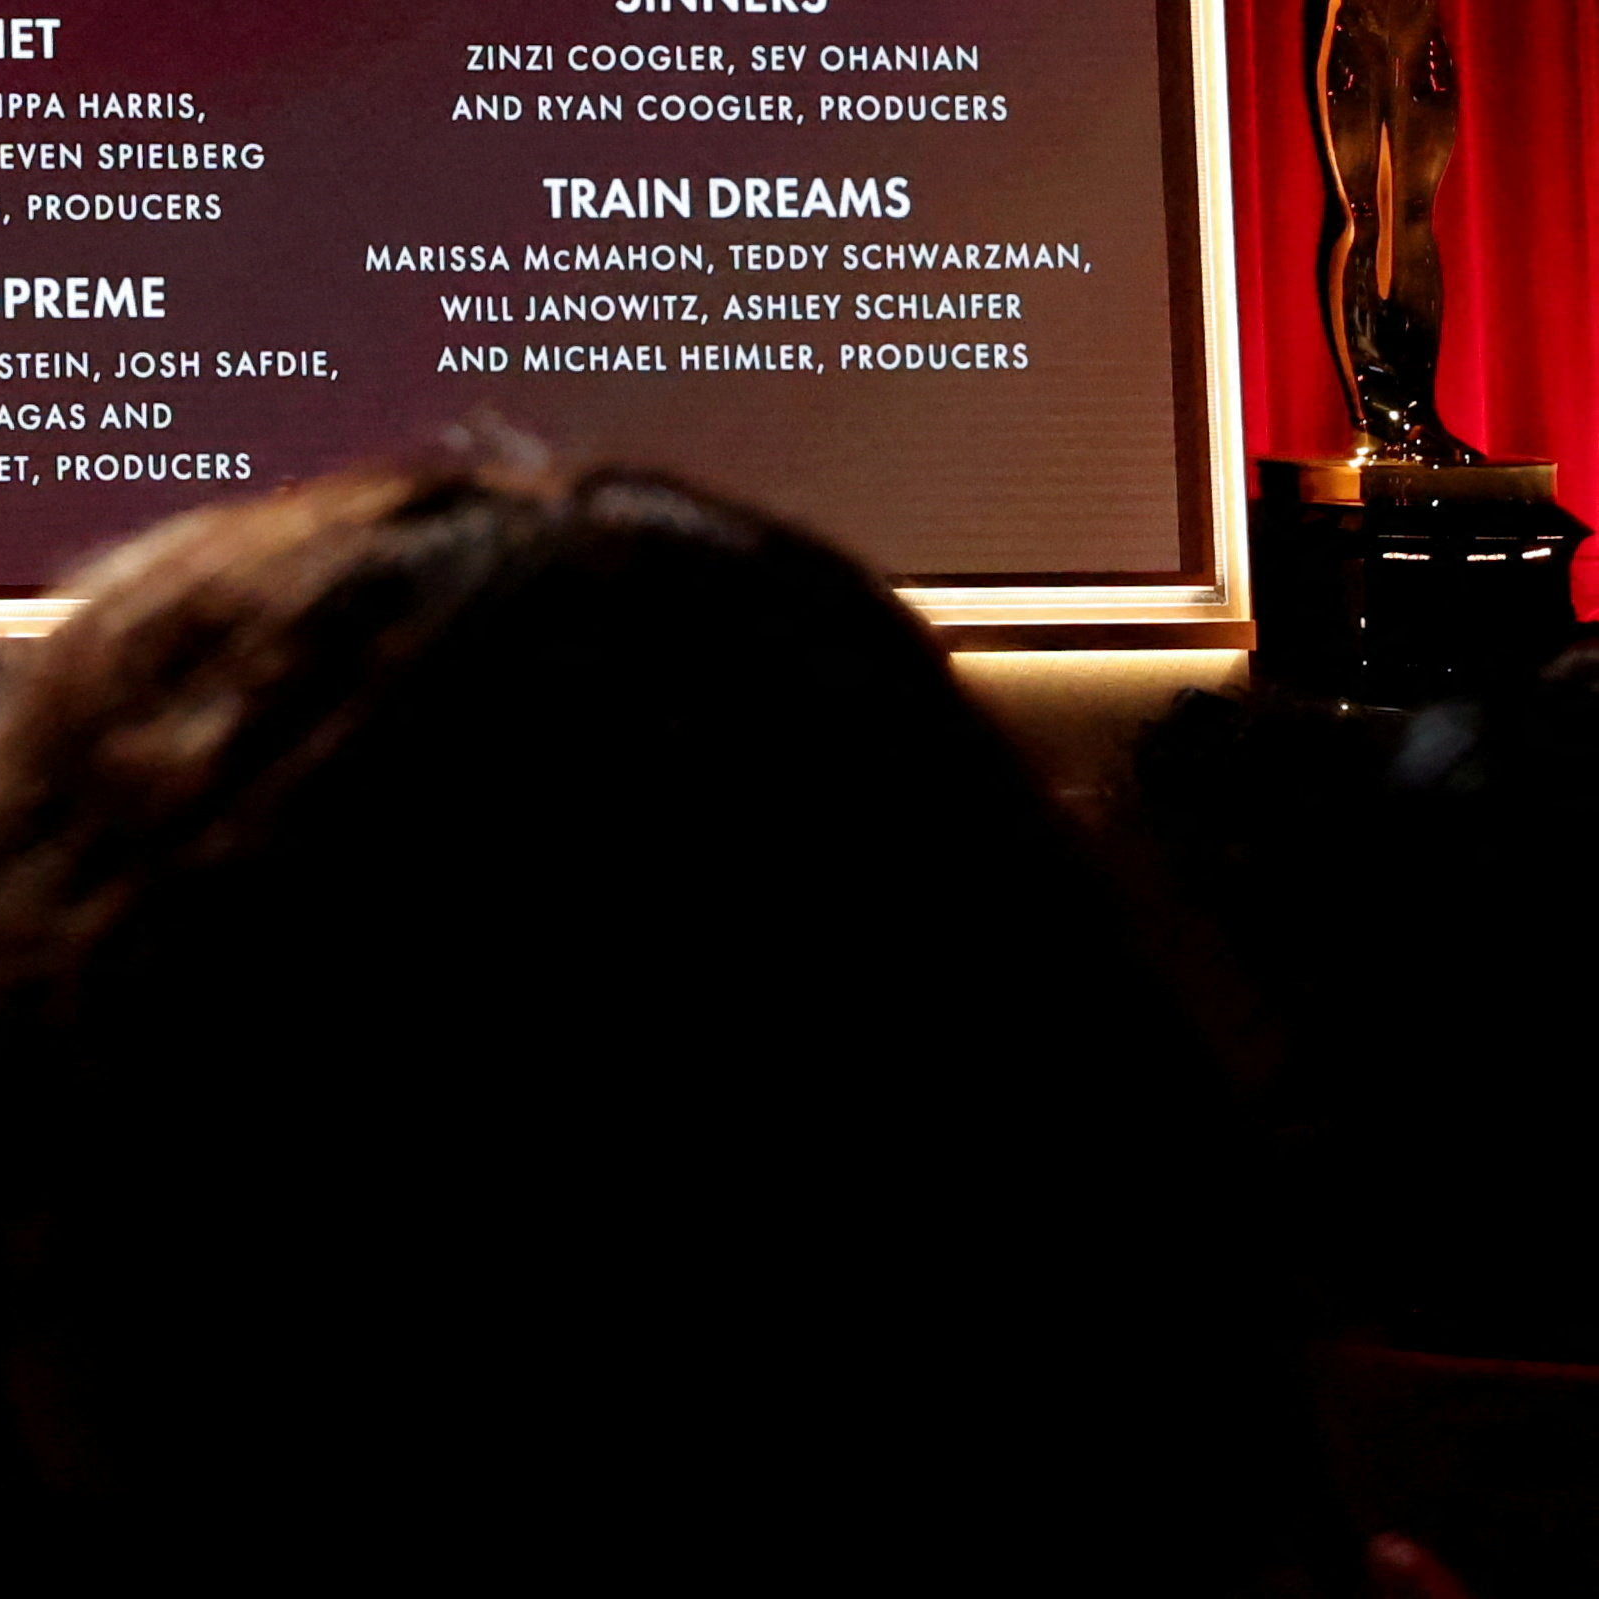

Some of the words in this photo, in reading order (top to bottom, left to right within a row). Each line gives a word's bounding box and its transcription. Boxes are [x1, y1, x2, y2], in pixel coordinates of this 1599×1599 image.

[466, 44, 553, 71] ZINZI
[568, 45, 735, 76] COOGLER,
[751, 44, 807, 71] SEV
[820, 45, 978, 72] OHANIAN
[79, 92, 205, 124] HARRIS,
[451, 94, 522, 121] AND
[537, 94, 622, 121] RYAN
[637, 94, 804, 125] COOGLER,
[820, 95, 1008, 121] PRODUCERS
[98, 143, 265, 170] SPIELBERG
[27, 193, 222, 221] PRODUCERS
[542, 177, 691, 219] TRAIN
[708, 176, 911, 219] DREAMS
[365, 245, 510, 272] MARISSA
[524, 244, 714, 275] McMAHON,
[728, 244, 829, 270] TEDDY
[843, 242, 1091, 274] SCHWARZMAN,
[440, 295, 514, 322] WILL
[524, 294, 708, 326] JANOWITZ,
[723, 294, 841, 321] ASHLEY
[855, 293, 1022, 320] SCHLAIFER
[114, 351, 200, 379] JOSH
[215, 350, 338, 381] SAFDIE,
[437, 345, 508, 372] AND
[523, 345, 667, 372] MICHAEL
[680, 343, 824, 375] HEIMLER,
[840, 342, 1029, 370] PRODUCERS
[100, 402, 172, 429] AND
[56, 452, 251, 481] PRODUCERS
